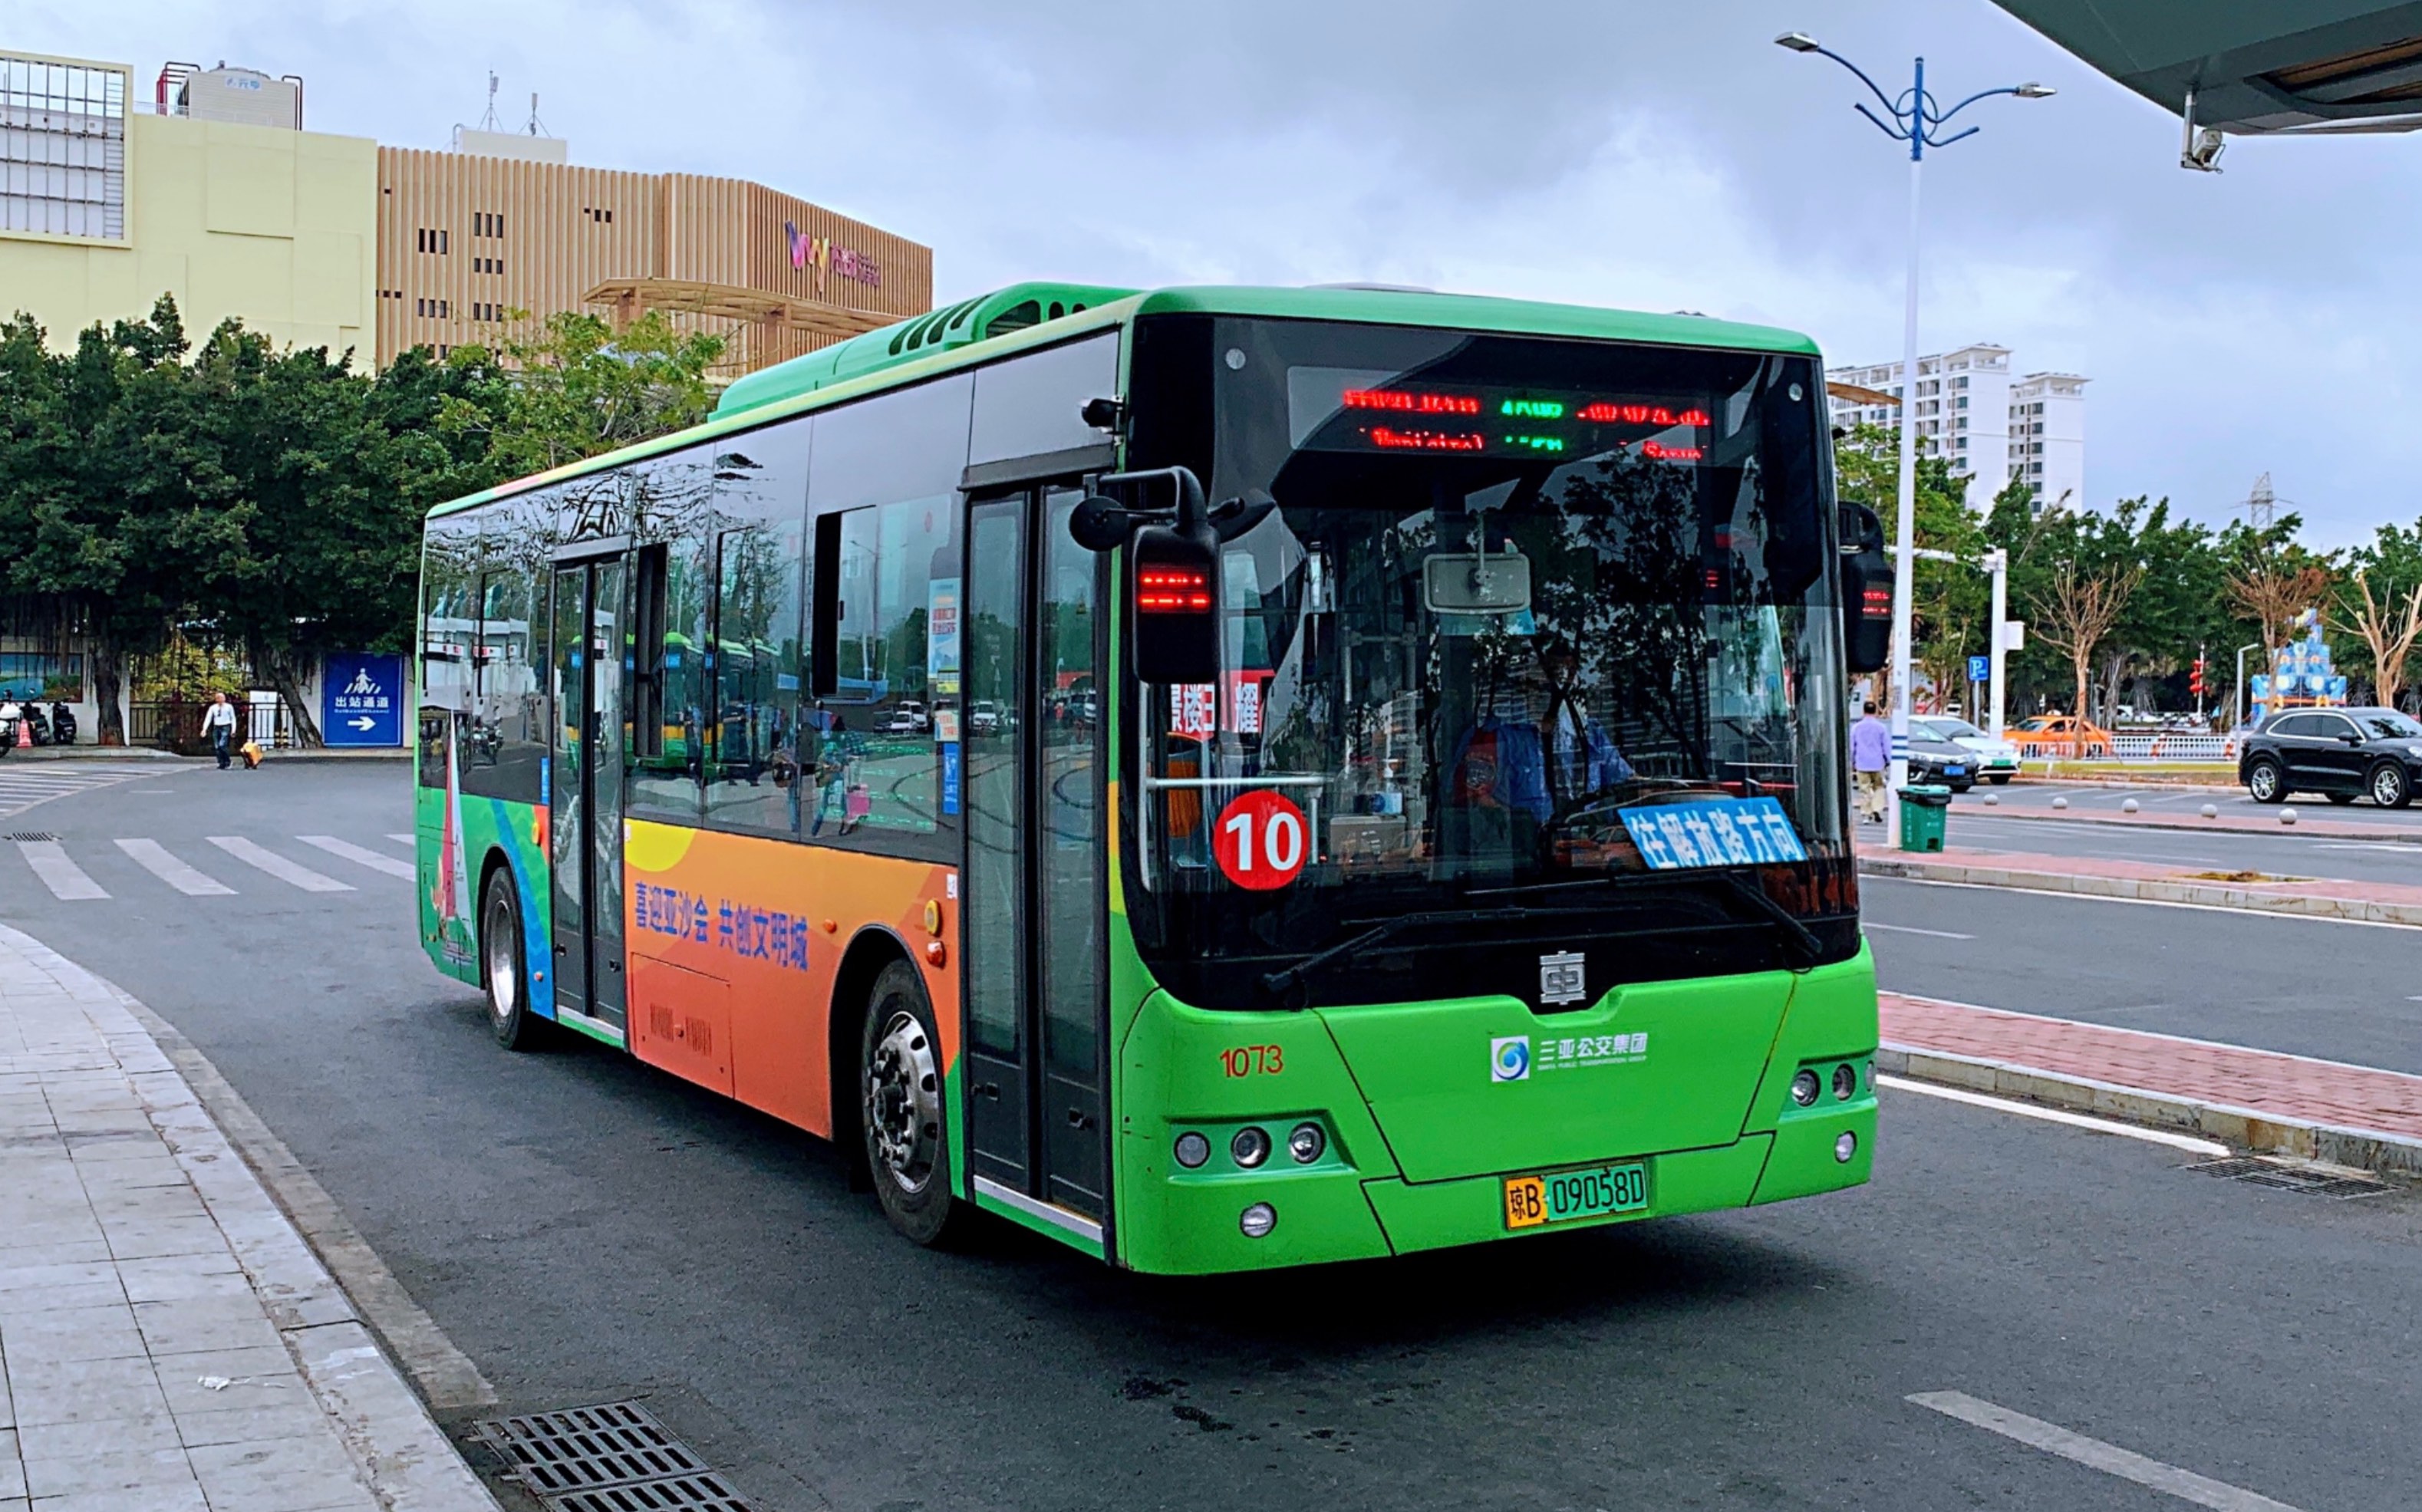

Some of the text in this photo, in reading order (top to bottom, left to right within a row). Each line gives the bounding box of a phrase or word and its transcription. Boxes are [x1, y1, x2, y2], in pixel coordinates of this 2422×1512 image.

[1971, 659, 1983, 677] P
[334, 696, 389, 708] 出站通道
[1226, 812, 1302, 871] 10
[1629, 804, 1803, 869] 往解放路方向
[635, 881, 808, 972] 喜迎亚沙会 共创文明城
[1219, 1045, 1283, 1078] 1073
[1539, 1033, 1648, 1061] 三亚公交集团
[1510, 1169, 1645, 1220] 琼B 09058D
